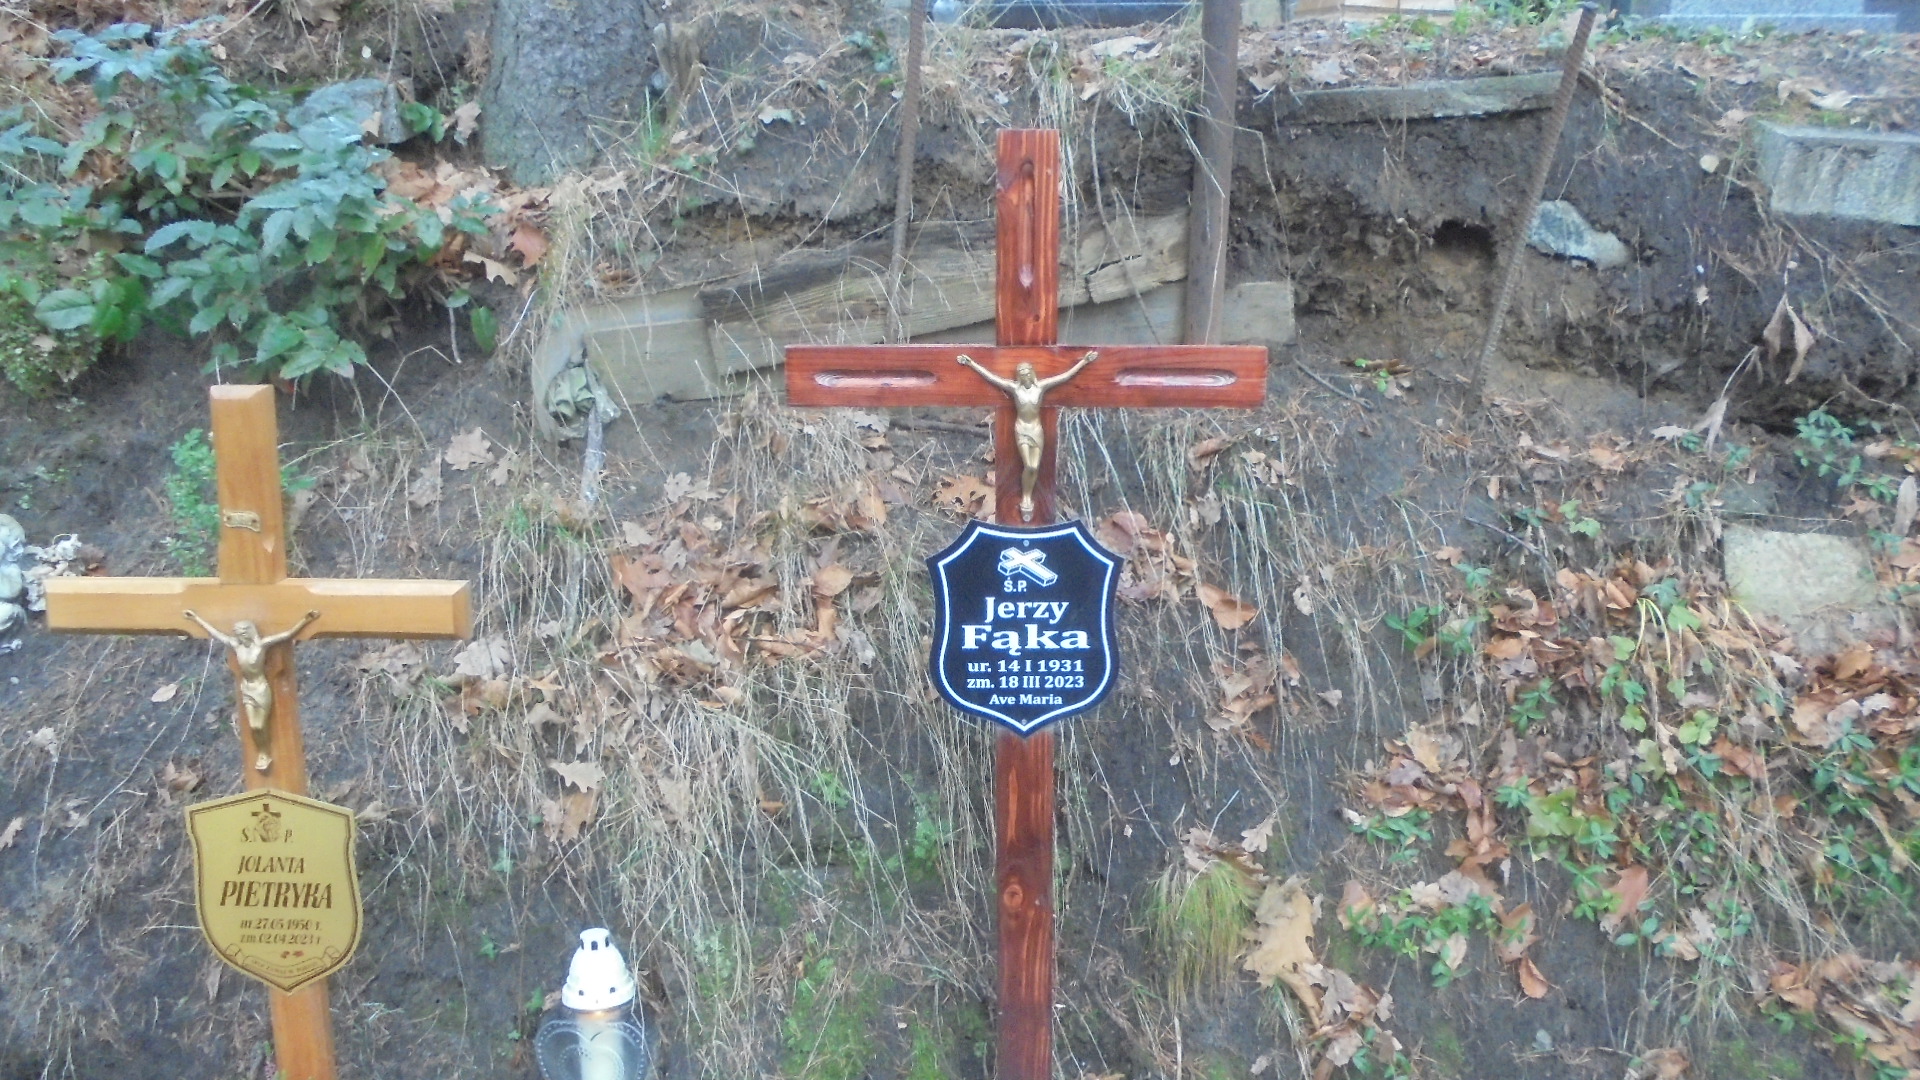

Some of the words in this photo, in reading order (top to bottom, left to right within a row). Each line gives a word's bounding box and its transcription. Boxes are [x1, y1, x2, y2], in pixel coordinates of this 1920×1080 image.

[984, 596, 1070, 625] Jerzy
[961, 623, 1091, 656] Fąka
[967, 661, 992, 673] ur.
[997, 659, 1021, 672] 14
[1025, 659, 1032, 672] I
[1037, 659, 1084, 672] 1931
[966, 677, 995, 689] zm.
[999, 675, 1019, 689] 18
[1022, 675, 1041, 689] III
[1044, 675, 1085, 689] 2023
[989, 694, 1016, 705] Ave
[1019, 693, 1063, 705] Maria
[237, 855, 305, 875] JOLANTA
[219, 880, 333, 909] PIETRYKA
